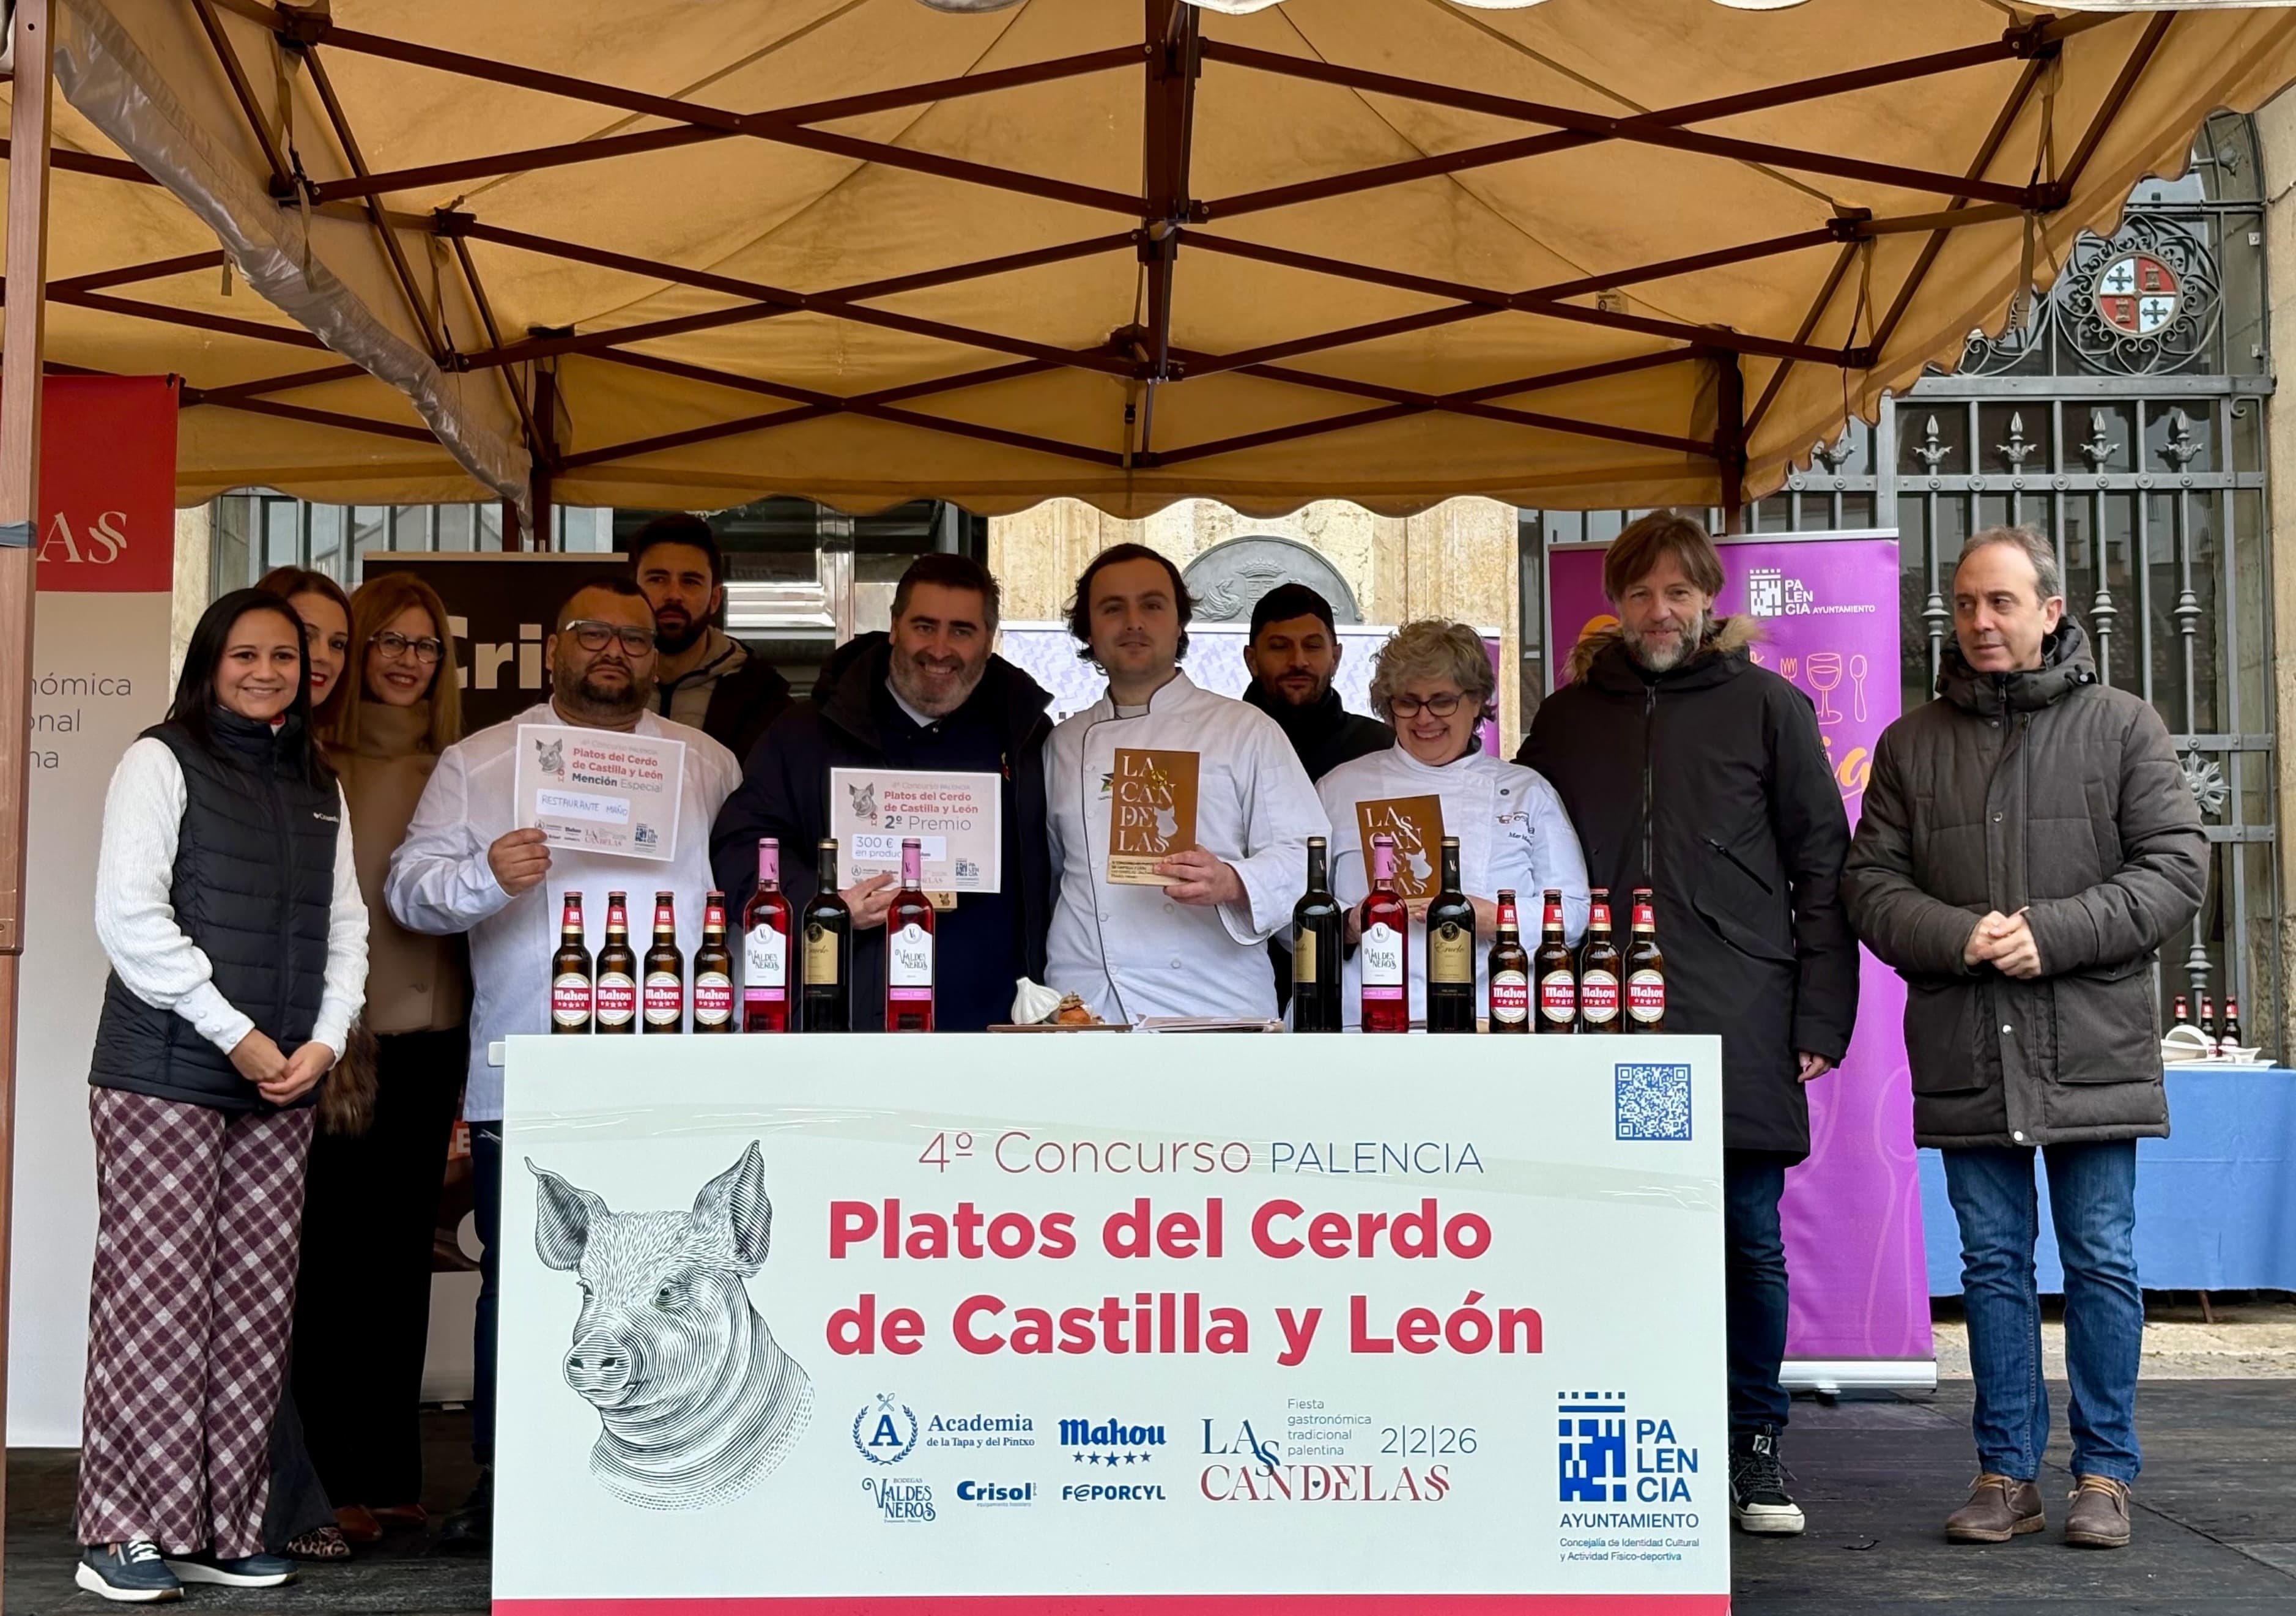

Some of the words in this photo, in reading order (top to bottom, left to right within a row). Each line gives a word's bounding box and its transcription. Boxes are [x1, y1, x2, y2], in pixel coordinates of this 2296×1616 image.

[1785, 579, 1803, 591] PA
[1785, 591, 1813, 602] LEN
[1785, 602, 1810, 615] CIA
[1813, 605, 1875, 614] AYUNTAMIENTO
[573, 748, 605, 759] Platos
[609, 752, 624, 762] del
[628, 755, 658, 766] Cerdo
[572, 760, 585, 769] de
[588, 762, 626, 775] Castilla
[639, 769, 663, 780] León
[572, 773, 617, 787] Mención
[621, 779, 663, 793] Especial
[884, 791, 917, 800] Platos
[920, 792, 936, 801] del
[939, 793, 971, 801] Cerdo
[1120, 781, 1176, 803] CAN
[542, 795, 600, 812] RESTAURANTE
[884, 803, 897, 812] de
[900, 804, 939, 813] Castilla
[952, 804, 978, 814] León
[884, 815, 902, 829] 2º
[909, 815, 971, 831] Premio
[1120, 806, 1152, 827] DE
[1365, 806, 1413, 834] LAS
[856, 837, 882, 848] 300
[886, 838, 894, 848] €
[1118, 830, 1169, 853] LAS
[747, 949, 778, 964] VALDES
[895, 949, 925, 964] VALDES
[1365, 948, 1394, 963] VALDES
[555, 990, 589, 1001] Mahou
[598, 989, 632, 1000] Mahou
[645, 988, 679, 1000] Mahou
[696, 988, 730, 1000] Mahou
[1494, 987, 1527, 998] Mahou
[1582, 987, 1615, 998] Mahou
[919, 1132, 973, 1173] 4º
[996, 1132, 1251, 1173] Concurso
[1272, 1142, 1484, 1173] PALENCIA
[830, 1198, 1076, 1259] Platos
[1103, 1197, 1223, 1259] del
[1251, 1198, 1492, 1259] Cerdo
[826, 1293, 925, 1355] de
[953, 1292, 1249, 1355] Castilla
[1275, 1308, 1324, 1367] y
[1350, 1290, 1544, 1355] León
[1288, 1398, 1324, 1409] Fiesta
[927, 1414, 1034, 1432] Academia
[1288, 1414, 1372, 1426] gastronómica
[1058, 1418, 1167, 1446] Mahou
[1288, 1428, 1352, 1440] tradicional
[1636, 1418, 1677, 1445] PA
[927, 1437, 938, 1447] de
[941, 1437, 950, 1447] la
[952, 1437, 974, 1448] Tapa
[976, 1439, 983, 1448] y
[986, 1437, 1000, 1447] del
[1003, 1437, 1035, 1447] Pintxo
[1201, 1418, 1280, 1477] LAS
[1288, 1444, 1344, 1457] palentina
[1636, 1448, 1698, 1473] LEN
[957, 1480, 1032, 1501] Crisol
[1201, 1464, 1450, 1502] CANDELAS
[1636, 1477, 1692, 1503] CIA
[862, 1477, 933, 1508] VALDES
[884, 1502, 936, 1522] NEROS
[1560, 1513, 1699, 1529] AYUNTAMIENTO
[1560, 1537, 1605, 1549] Concejalía
[1608, 1538, 1620, 1547] de
[1622, 1538, 1663, 1547] Identidad
[1665, 1538, 1699, 1547] Cultural
[1560, 1554, 1565, 1562] y
[1568, 1552, 1609, 1561] Actividad
